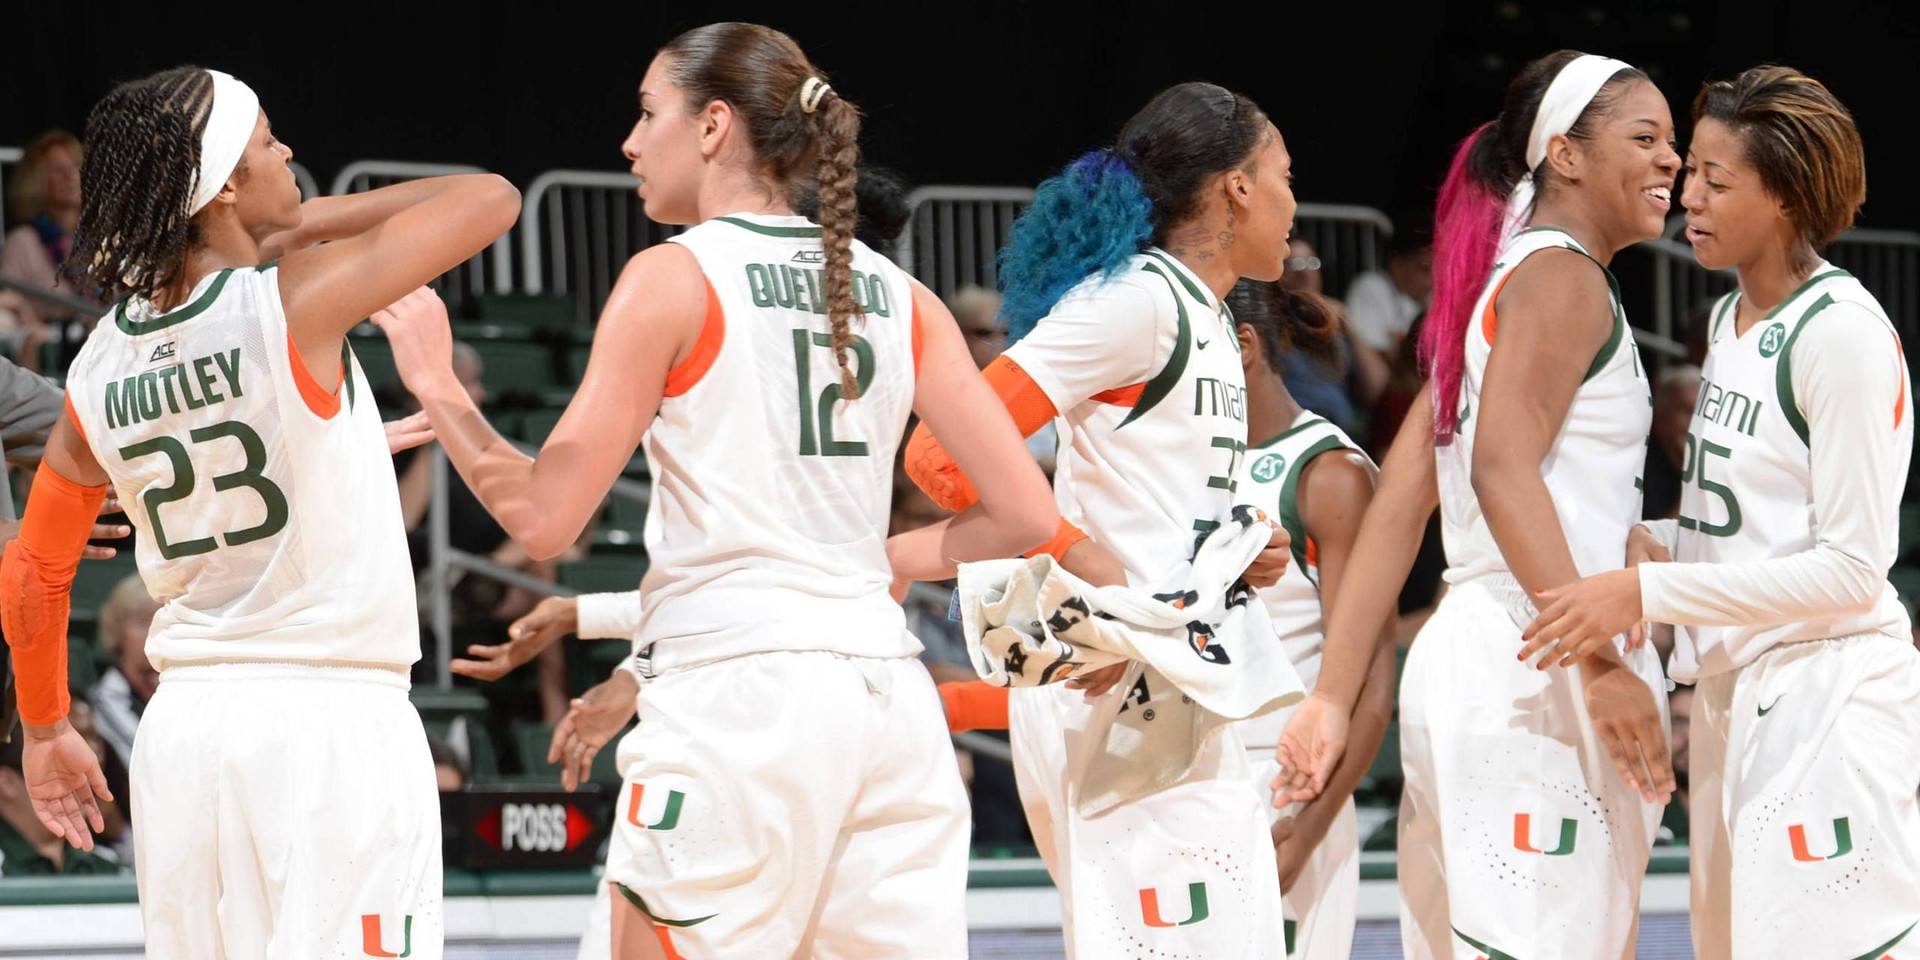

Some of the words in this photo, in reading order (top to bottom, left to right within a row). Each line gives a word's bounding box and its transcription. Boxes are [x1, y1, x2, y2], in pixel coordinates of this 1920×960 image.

[746, 263, 890, 318] QUEVDO
[149, 341, 175, 363] ACC
[104, 347, 243, 430] MOTLEY
[792, 328, 876, 457] 12
[118, 420, 289, 561] 23
[1252, 455, 1285, 480] ES
[501, 802, 568, 852] POSS
[628, 782, 686, 831] U
[1513, 813, 1579, 856] U
[1787, 816, 1854, 862] U
[1138, 881, 1210, 929] U
[361, 914, 413, 959] U
